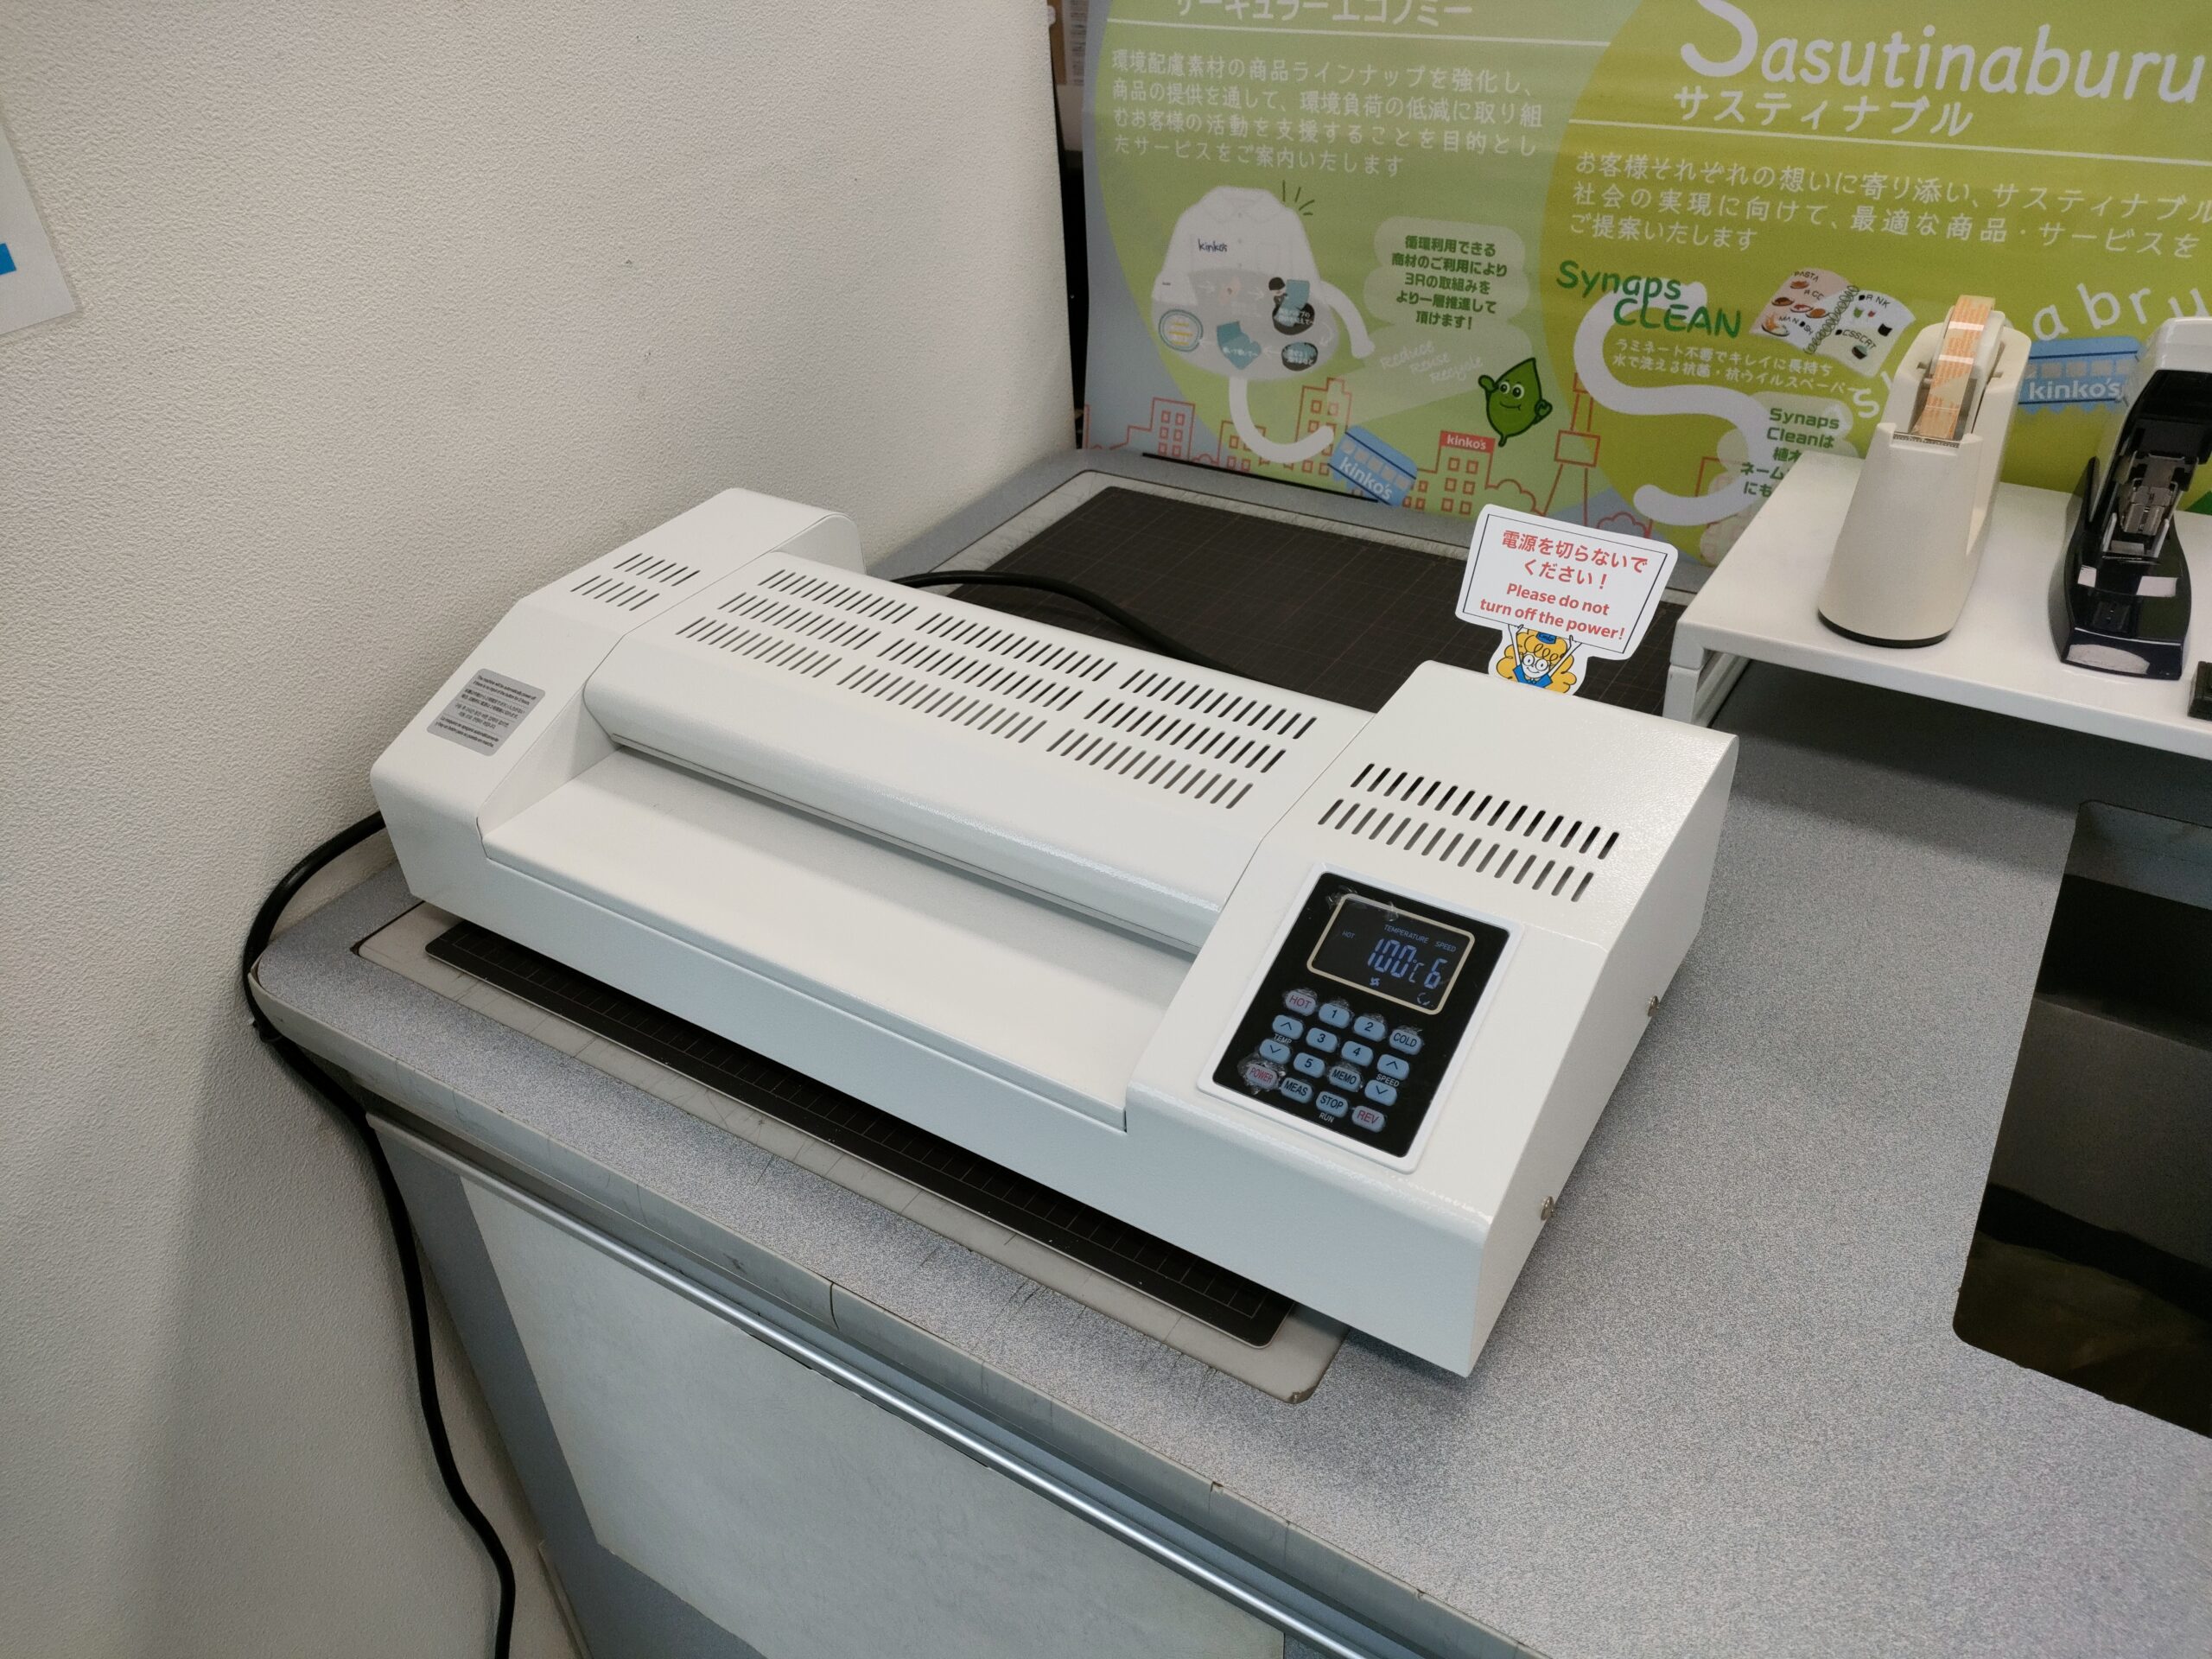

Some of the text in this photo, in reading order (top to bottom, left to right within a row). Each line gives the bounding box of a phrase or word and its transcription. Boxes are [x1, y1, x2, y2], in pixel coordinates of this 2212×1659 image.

[1680, 0, 2207, 103] Sasutinaburu
[1674, 86, 1975, 137] サスティナブル
[1569, 213, 1758, 251] ご提案いたします
[1405, 272, 1491, 295] 3Rの取組みを
[1556, 260, 1682, 305] Synaps
[1613, 298, 1741, 338] CLEAN
[2029, 378, 2120, 400] kinko's
[1770, 408, 1840, 429] Synaps
[1446, 434, 1487, 451] kinko's
[1339, 456, 1393, 500] kinko's
[1501, 530, 1648, 573] 電源を切らないで
[1524, 559, 1607, 589] ください！
[1506, 583, 1610, 616] Please do not
[1480, 599, 1512, 616] turn
[1515, 607, 1538, 621] off
[1538, 610, 1564, 627] the
[1566, 620, 1625, 640] power!
[1383, 924, 1430, 944] TEMPERATURE
[1434, 941, 1457, 952] SPEED
[1289, 995, 1312, 1008] HOT
[1364, 1022, 1374, 1032] 2
[1273, 1033, 1292, 1044] TEMP
[1317, 1033, 1325, 1043] 3
[1393, 1033, 1417, 1047] COLD
[1353, 1047, 1361, 1056] 4
[1304, 1058, 1313, 1068] 5
[1249, 1067, 1274, 1084] POWER
[1332, 1069, 1357, 1084] MEMO
[1376, 1073, 1400, 1087] SPEED
[1284, 1079, 1308, 1096] MEAS
[1320, 1095, 1344, 1109] STOP
[1319, 1112, 1334, 1123] RUN
[1357, 1109, 1380, 1124] REV
